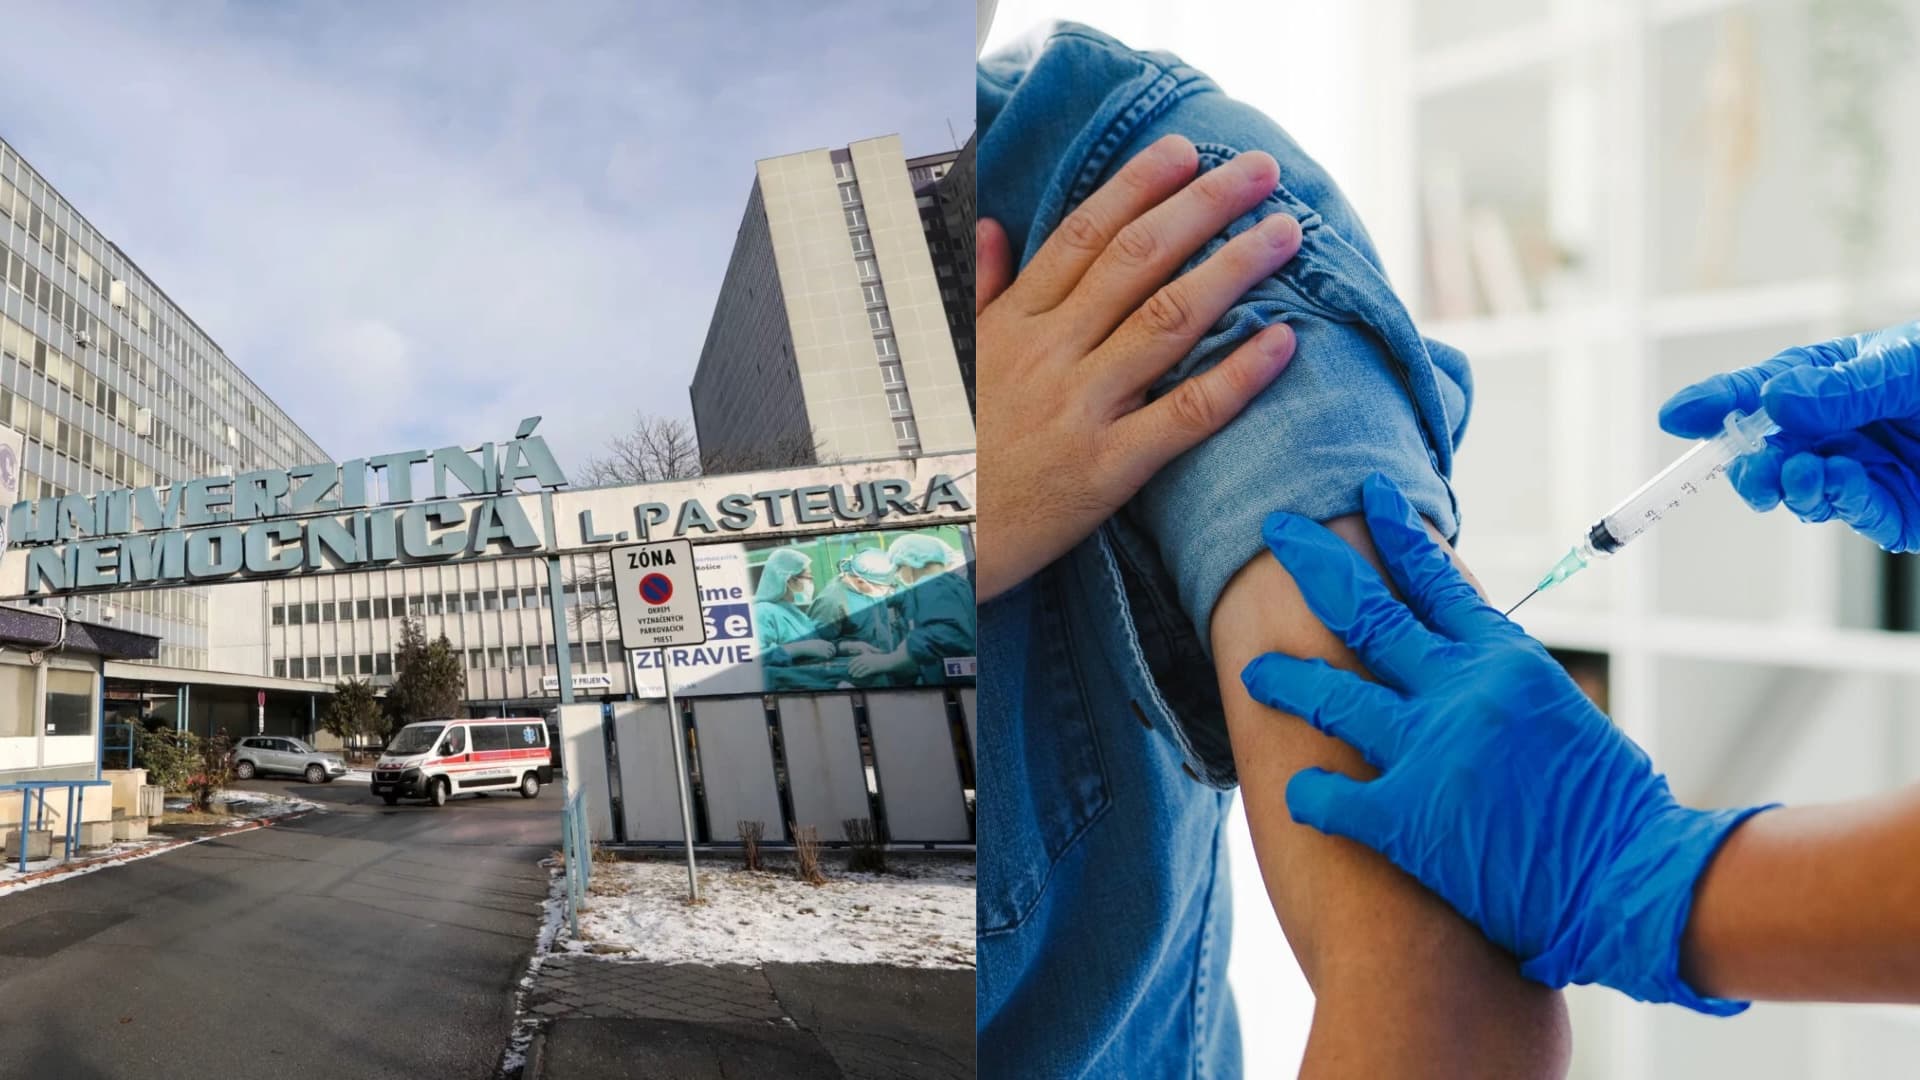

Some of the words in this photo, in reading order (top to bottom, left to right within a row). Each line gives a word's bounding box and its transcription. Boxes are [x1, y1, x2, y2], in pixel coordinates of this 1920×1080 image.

[12, 416, 568, 544] UNIVERZITNÁ
[27, 496, 542, 595] NEMOCNICA
[627, 547, 676, 569] ZÓNA
[699, 585, 743, 602] ime
[636, 645, 753, 669] ZDRAVIE
